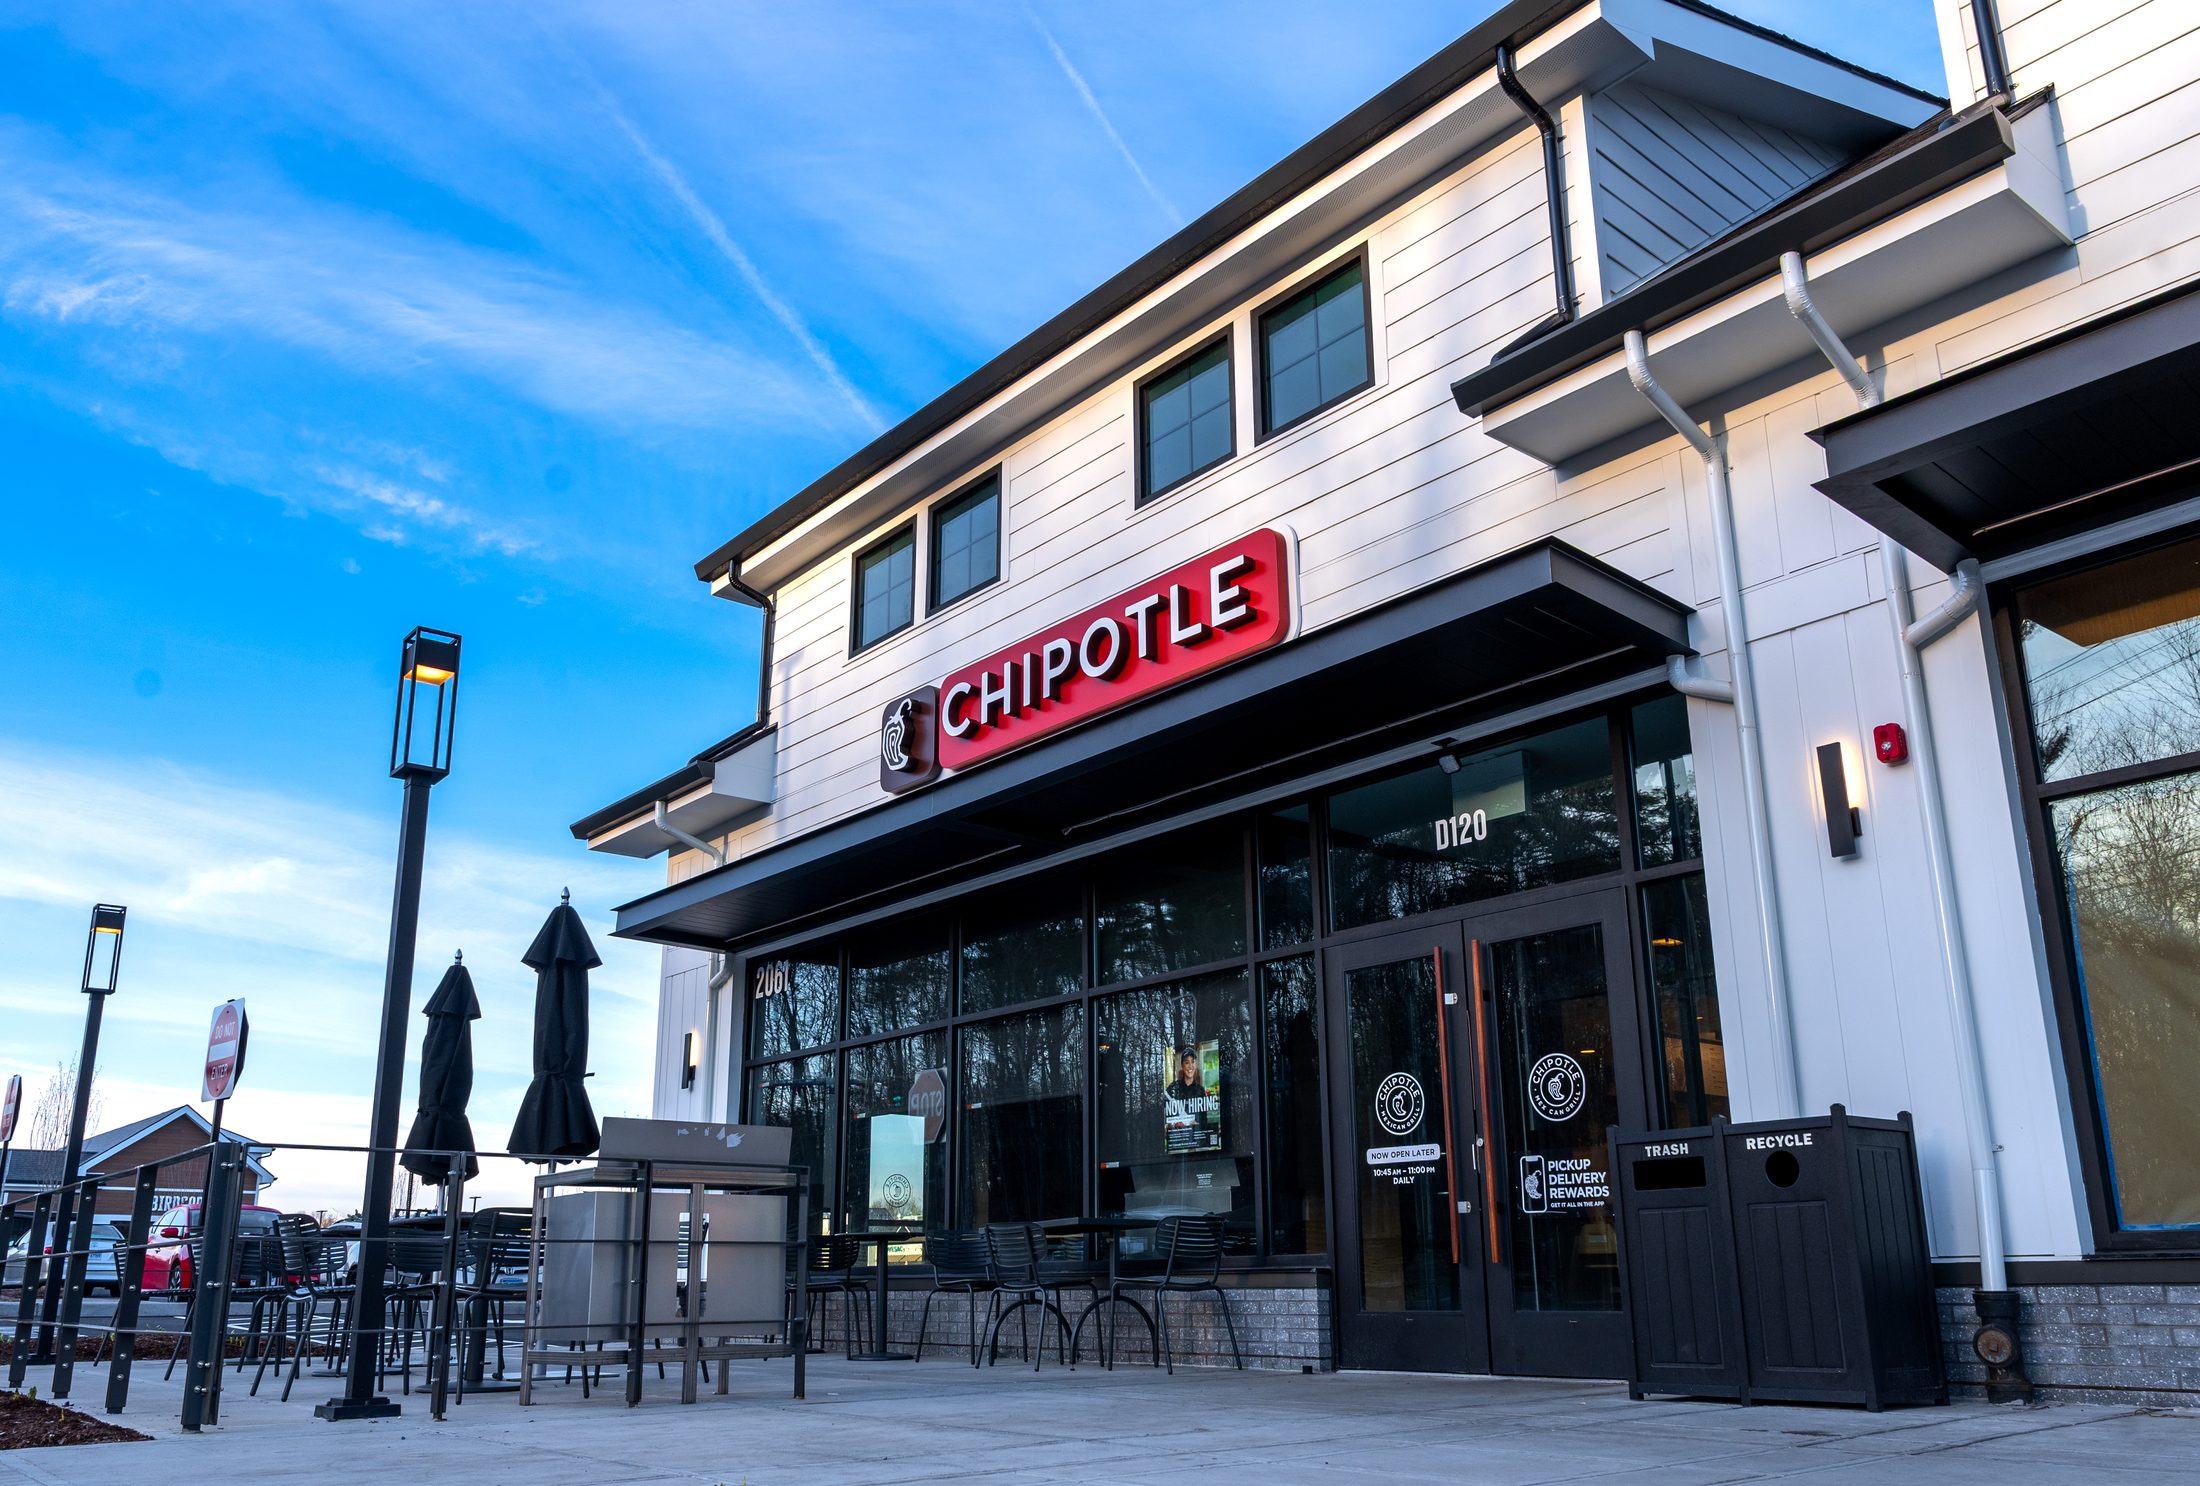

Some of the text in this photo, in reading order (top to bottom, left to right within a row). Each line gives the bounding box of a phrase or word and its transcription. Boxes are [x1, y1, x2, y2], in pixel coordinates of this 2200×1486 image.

[942, 554, 1250, 738] CHIPOTLE
[1435, 809, 1487, 851] D120
[755, 960, 789, 999] 2061
[215, 1021, 236, 1040] DO NOT
[210, 1063, 229, 1080] ENTER
[1533, 1057, 1581, 1084] CHIPOTLE
[1380, 1076, 1421, 1101] CHIPOTLE
[1165, 1095, 1219, 1116] NOW HIRING
[1565, 1091, 1581, 1112] GRILL
[1381, 1107, 1421, 1130] MEXICAN GRILL
[1644, 1143, 1689, 1158] TRASH
[1745, 1133, 1813, 1150] RECYCLE
[1371, 1148, 1435, 1160] NOW OPEN LATER
[1373, 1168, 1392, 1176] 10:45
[1408, 1166, 1426, 1174] 11:00
[1426, 1166, 1436, 1174] PM
[1547, 1158, 1591, 1172] PICKUP
[1393, 1176, 1415, 1184] DAILY
[1548, 1172, 1607, 1185] DELIVERY
[1549, 1186, 1610, 1199] REWARDS
